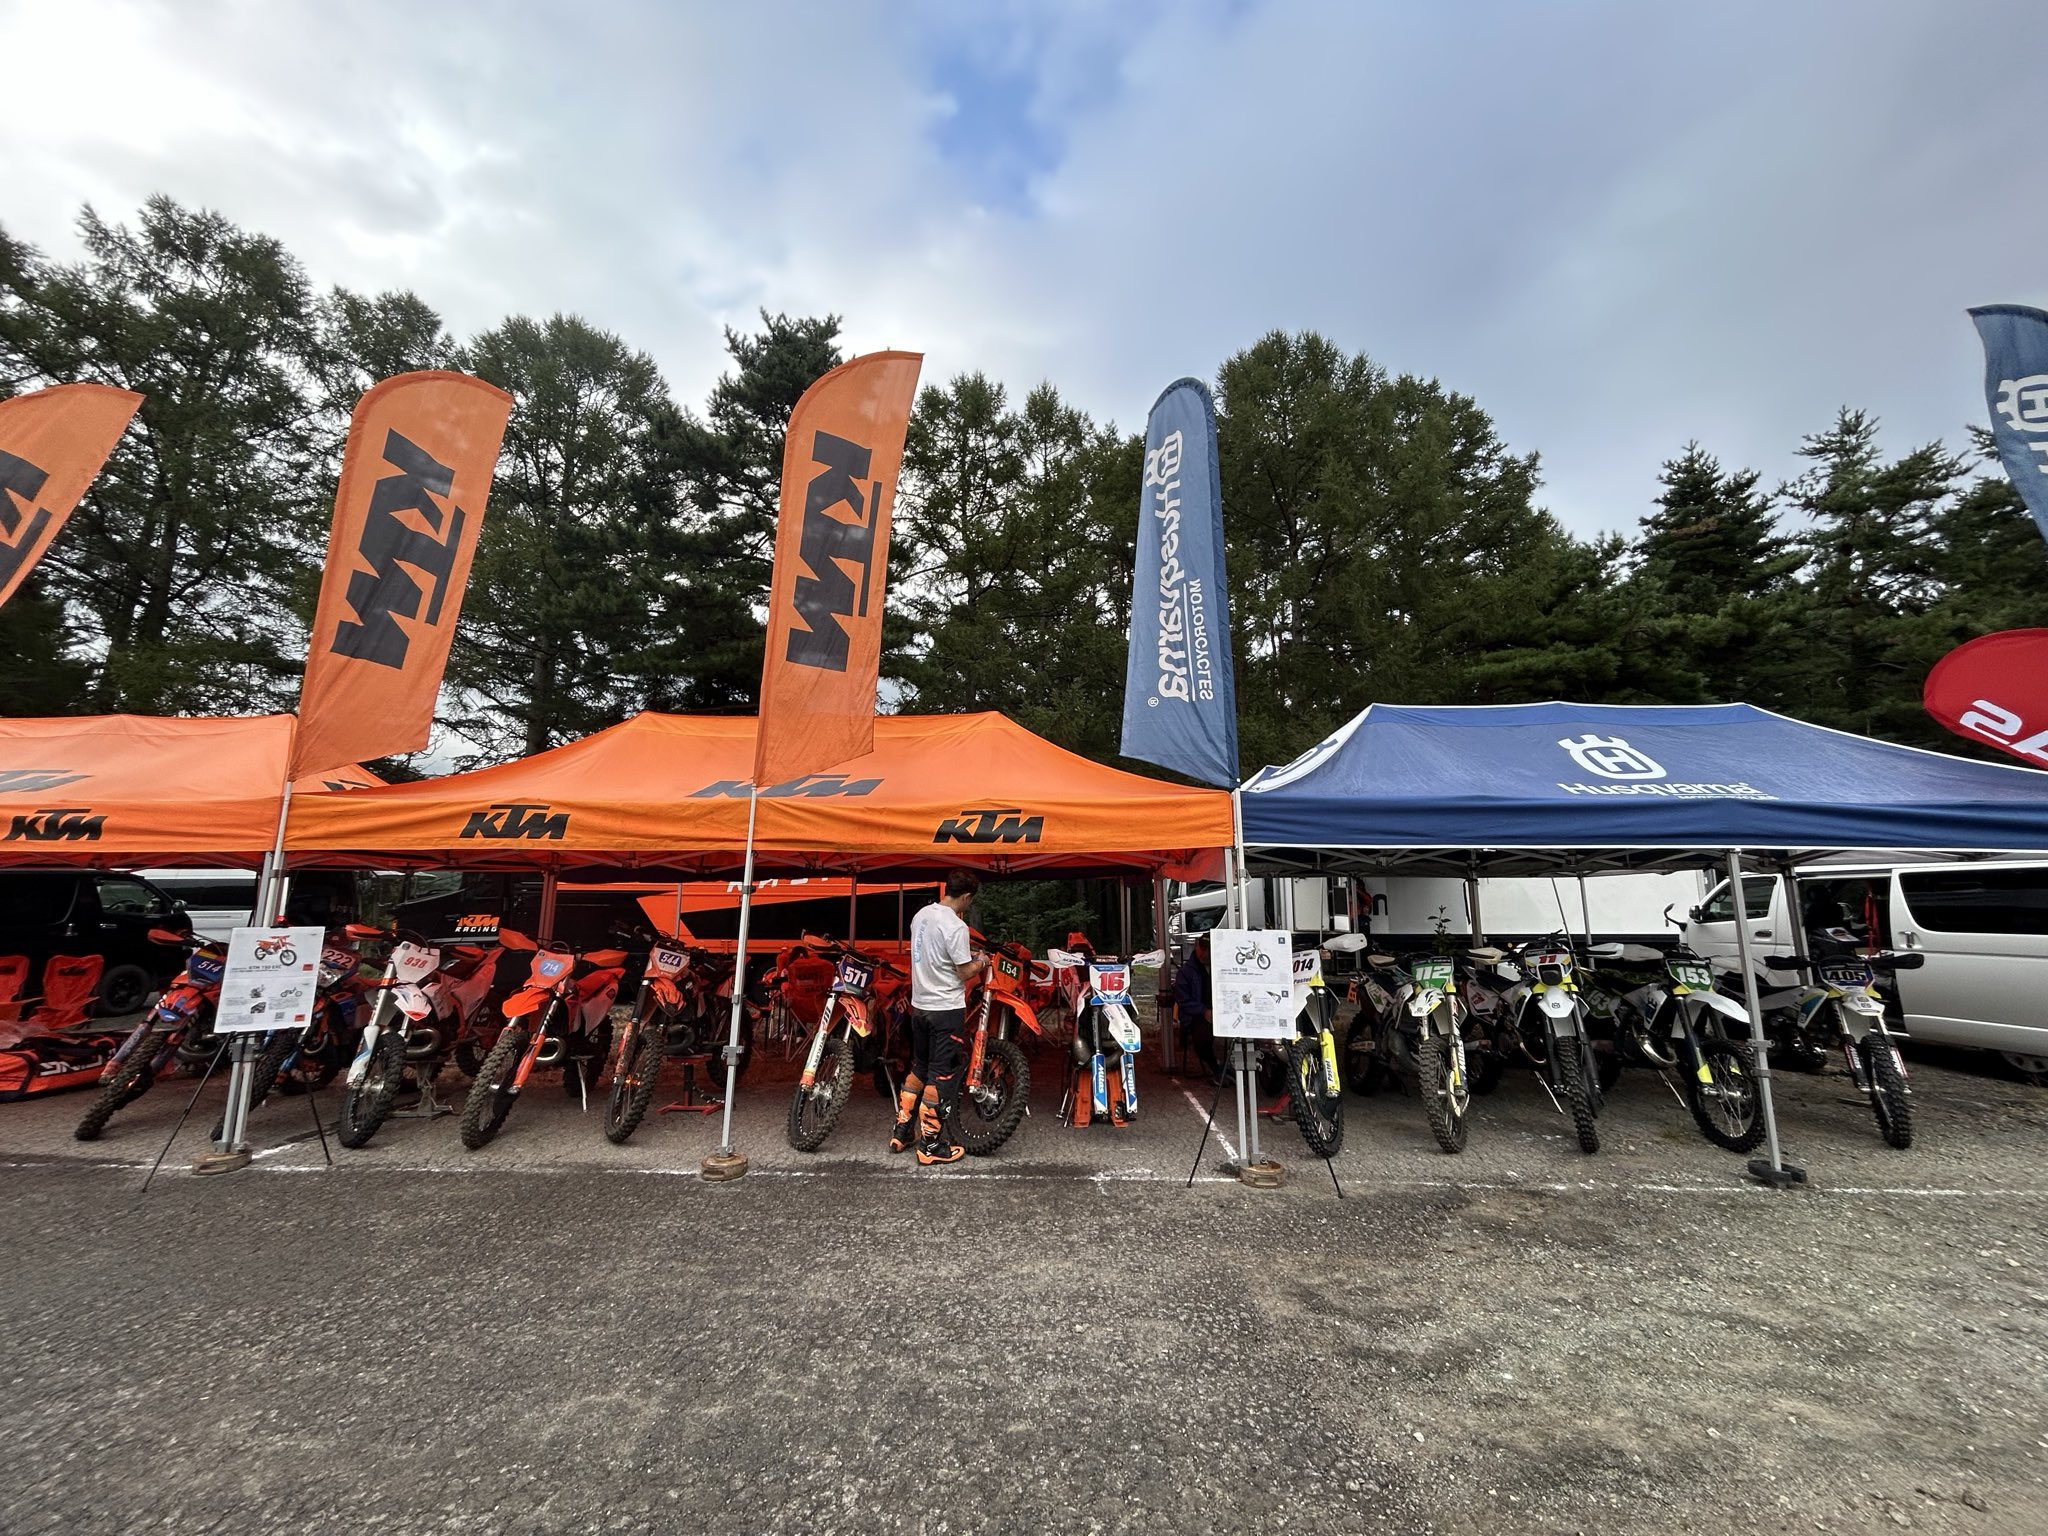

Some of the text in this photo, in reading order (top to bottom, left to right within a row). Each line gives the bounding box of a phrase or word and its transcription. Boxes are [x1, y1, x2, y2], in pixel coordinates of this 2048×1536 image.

[331, 427, 467, 670] KTM
[786, 430, 882, 672] KTM
[2, 808, 109, 841] KTM
[458, 804, 571, 839] KTM
[932, 809, 1044, 843] KTM
[458, 914, 500, 927] KTM
[197, 960, 222, 973] 514
[404, 956, 428, 969] 938
[543, 962, 559, 973] 714
[660, 953, 680, 966] 544
[843, 966, 868, 988] 571
[1001, 960, 1018, 978] 154
[1415, 966, 1453, 982] 112
[1676, 967, 1711, 986] 153
[1828, 970, 1867, 981] 405
[1098, 972, 1125, 991] 16
